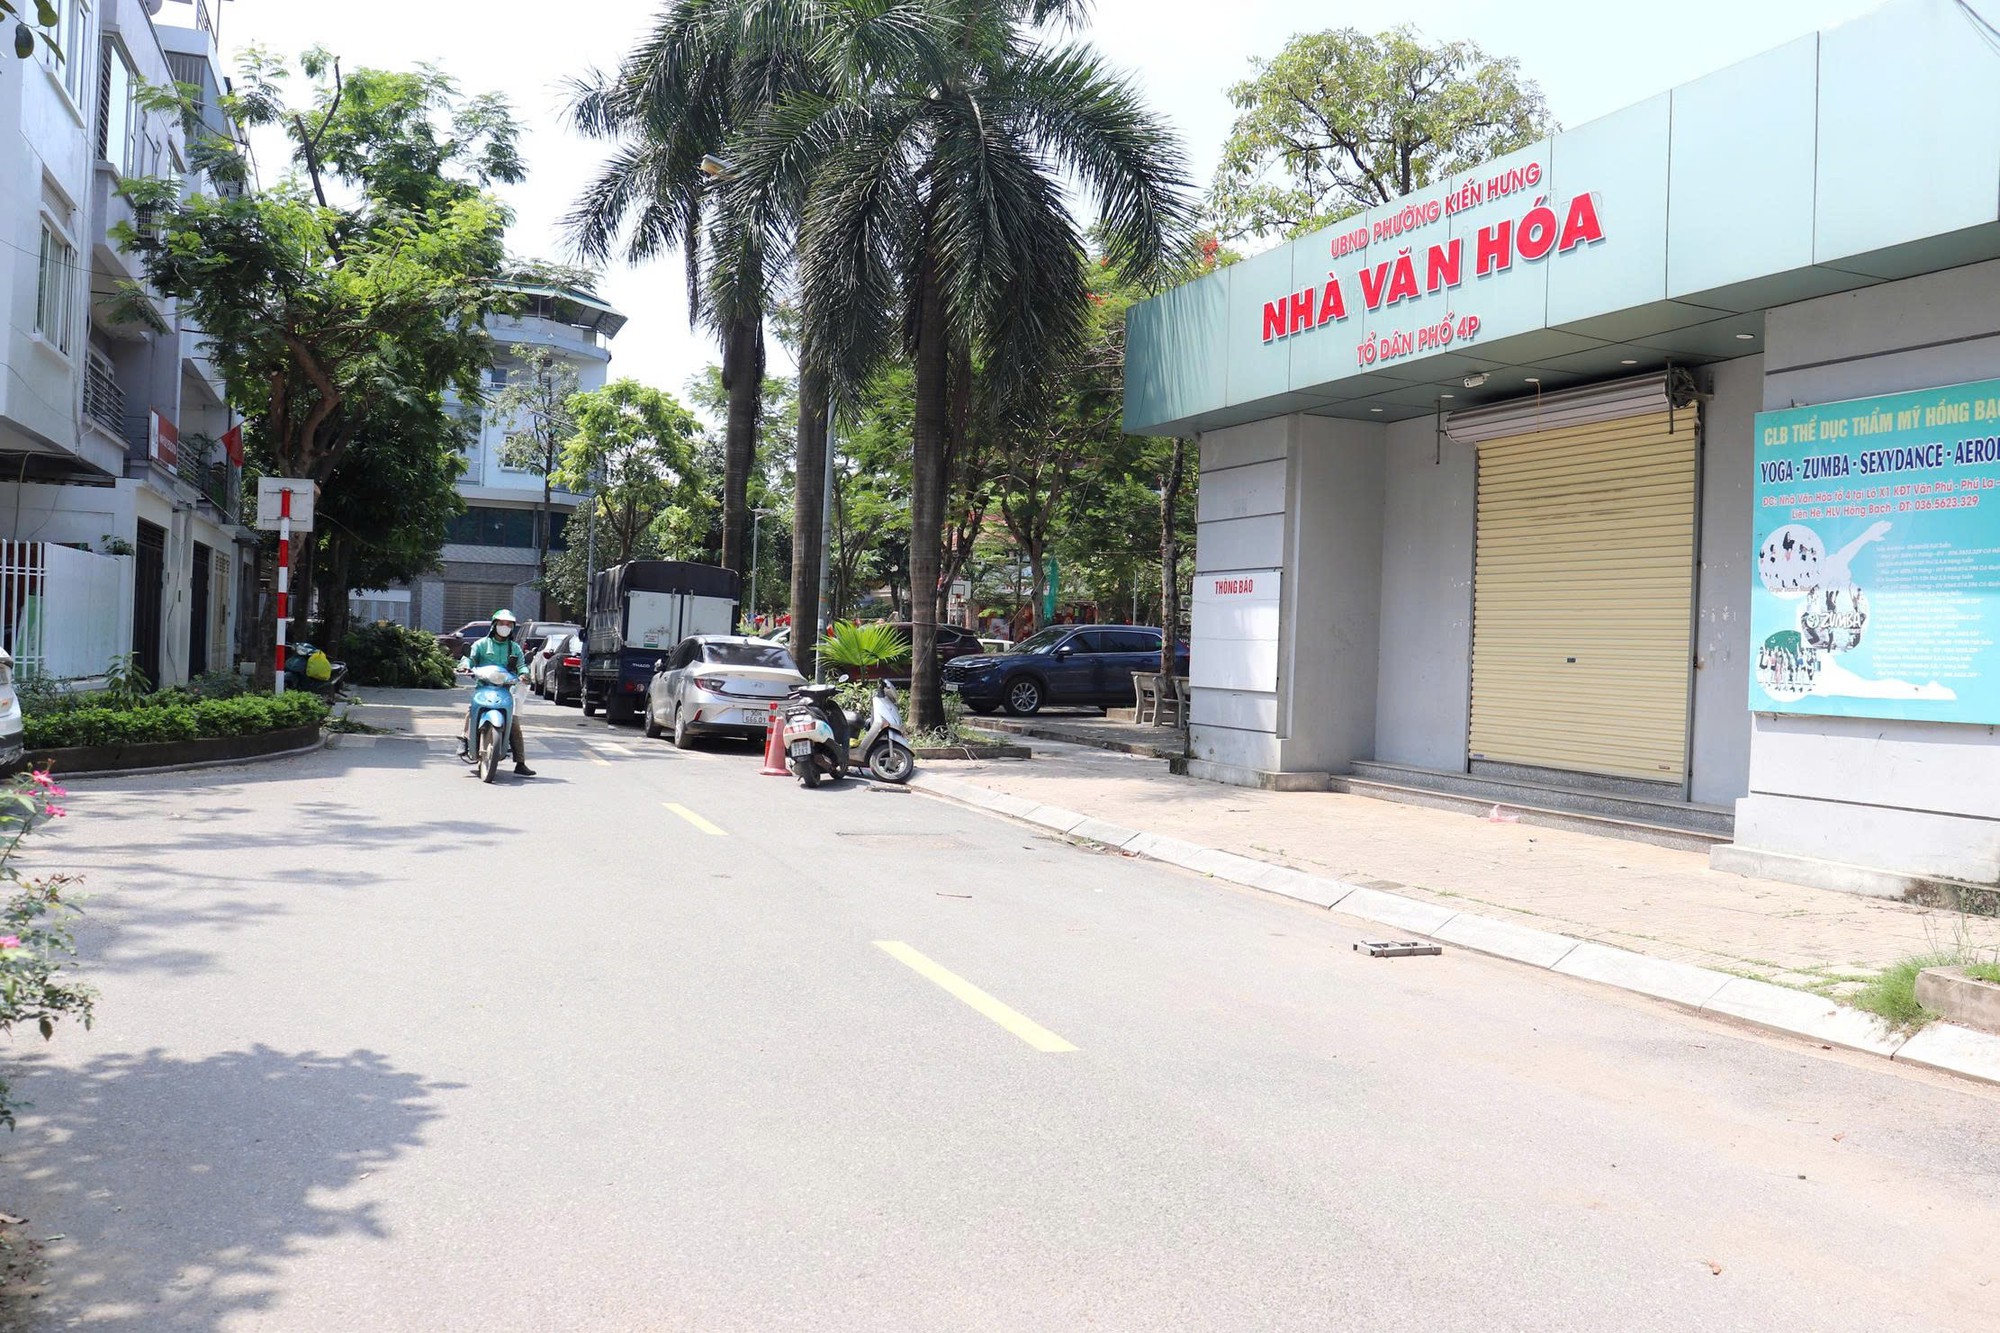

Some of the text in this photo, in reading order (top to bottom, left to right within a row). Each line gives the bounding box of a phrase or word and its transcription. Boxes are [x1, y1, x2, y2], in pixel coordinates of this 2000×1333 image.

[1330, 162, 1541, 259] UBND PHƯỜNG KIẾN HƯNG
[1262, 192, 1605, 343] NHÀ VĂN HÓA
[1357, 312, 1480, 366] TỔ DÂN PHỐ 4P
[1764, 398, 2000, 446] CLB THỂ DỤC THẨM MỸ HỒNG BẠ
[1761, 460, 1793, 483] YOGA
[1803, 454, 1849, 479] ZUMBA
[1860, 444, 1943, 475] SEXYDANCE
[1826, 507, 1842, 516] HLV
[1915, 496, 1978, 510] 036.5623.329
[1845, 491, 1851, 499] 4
[1893, 485, 1911, 496] KĐT
[1982, 478, 1994, 488] La
[1215, 577, 1253, 595] THÔNG BÁO
[1820, 612, 1861, 629] ZUMBA
